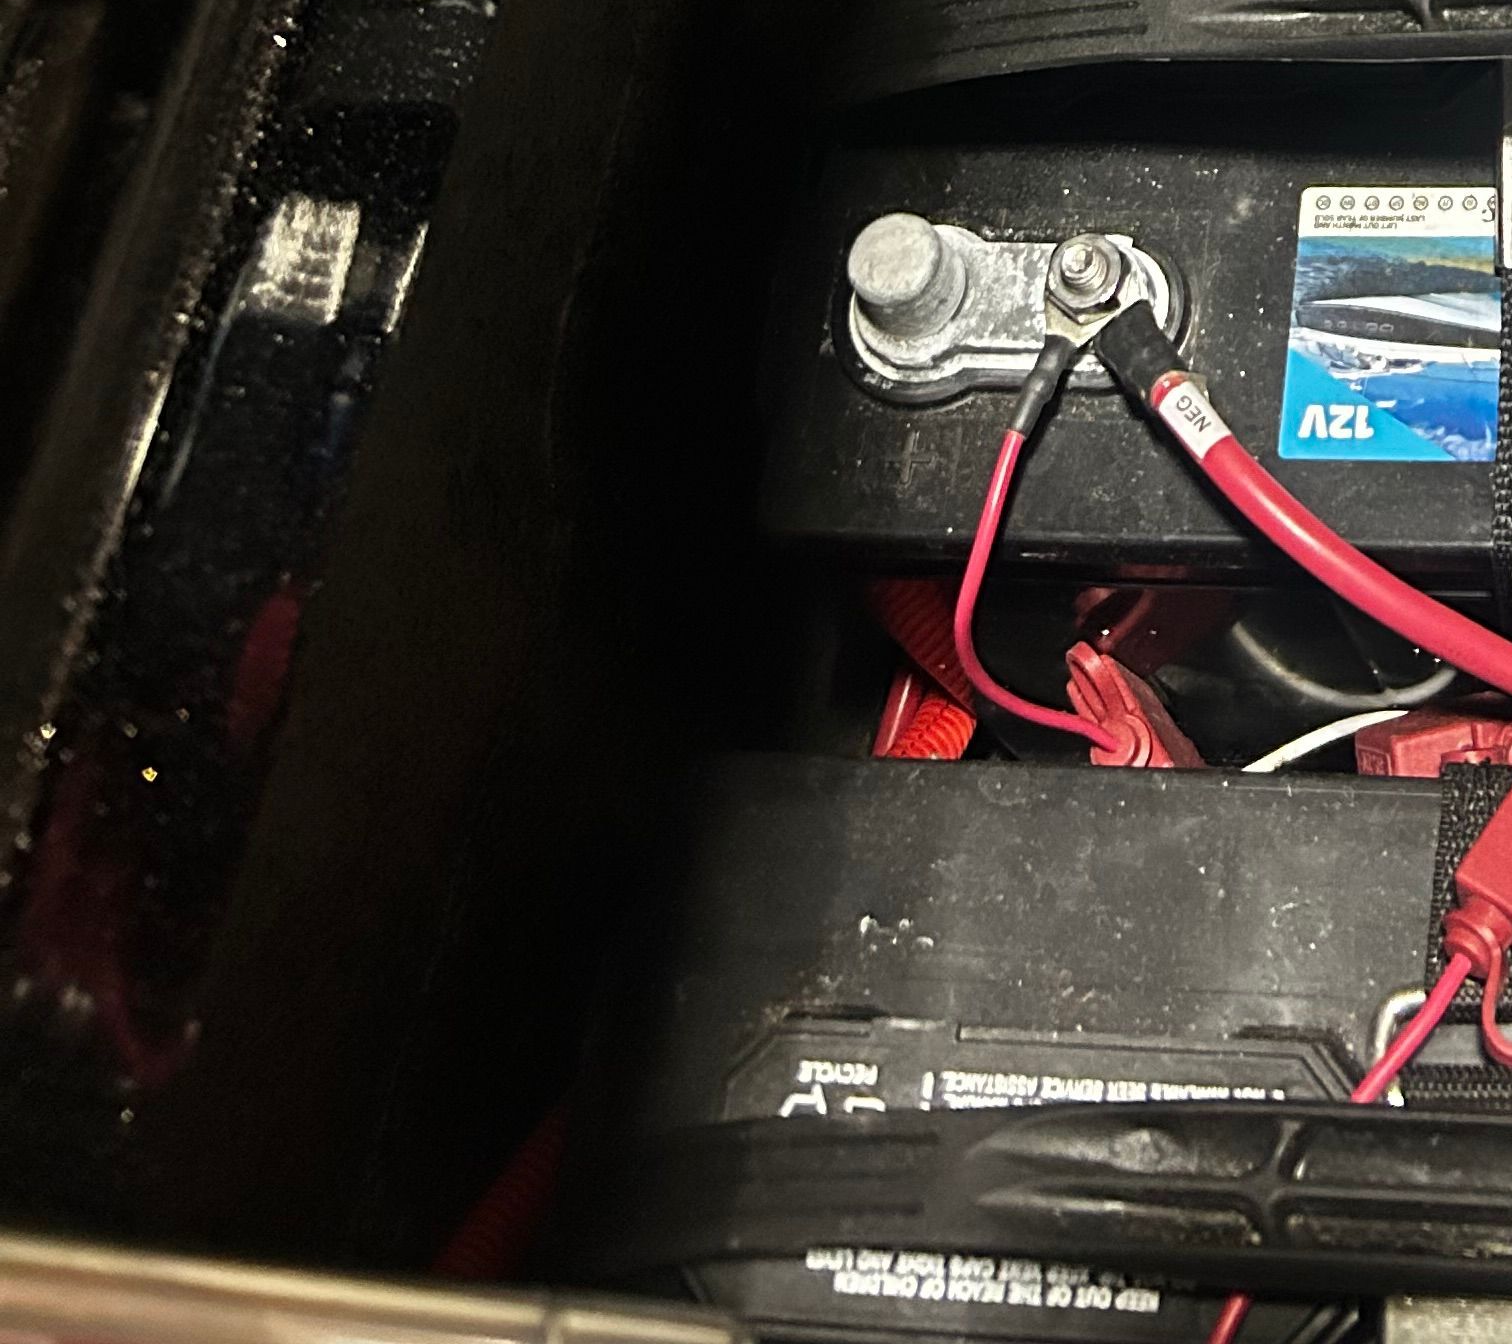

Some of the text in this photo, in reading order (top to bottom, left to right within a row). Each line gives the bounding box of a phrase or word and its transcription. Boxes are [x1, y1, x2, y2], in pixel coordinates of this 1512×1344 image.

[1176, 395, 1212, 433] NEG
[1297, 404, 1375, 440] 12V
[798, 1062, 878, 1086] RECYCLE
[1041, 1077, 1105, 1103] SERVICE
[1106, 1081, 1148, 1103] SEEK
[856, 1250, 894, 1273] AND
[949, 1255, 997, 1280] CAPS
[832, 1272, 1160, 1313] KEEP OUT OF THE REACH OF CHILDREN
